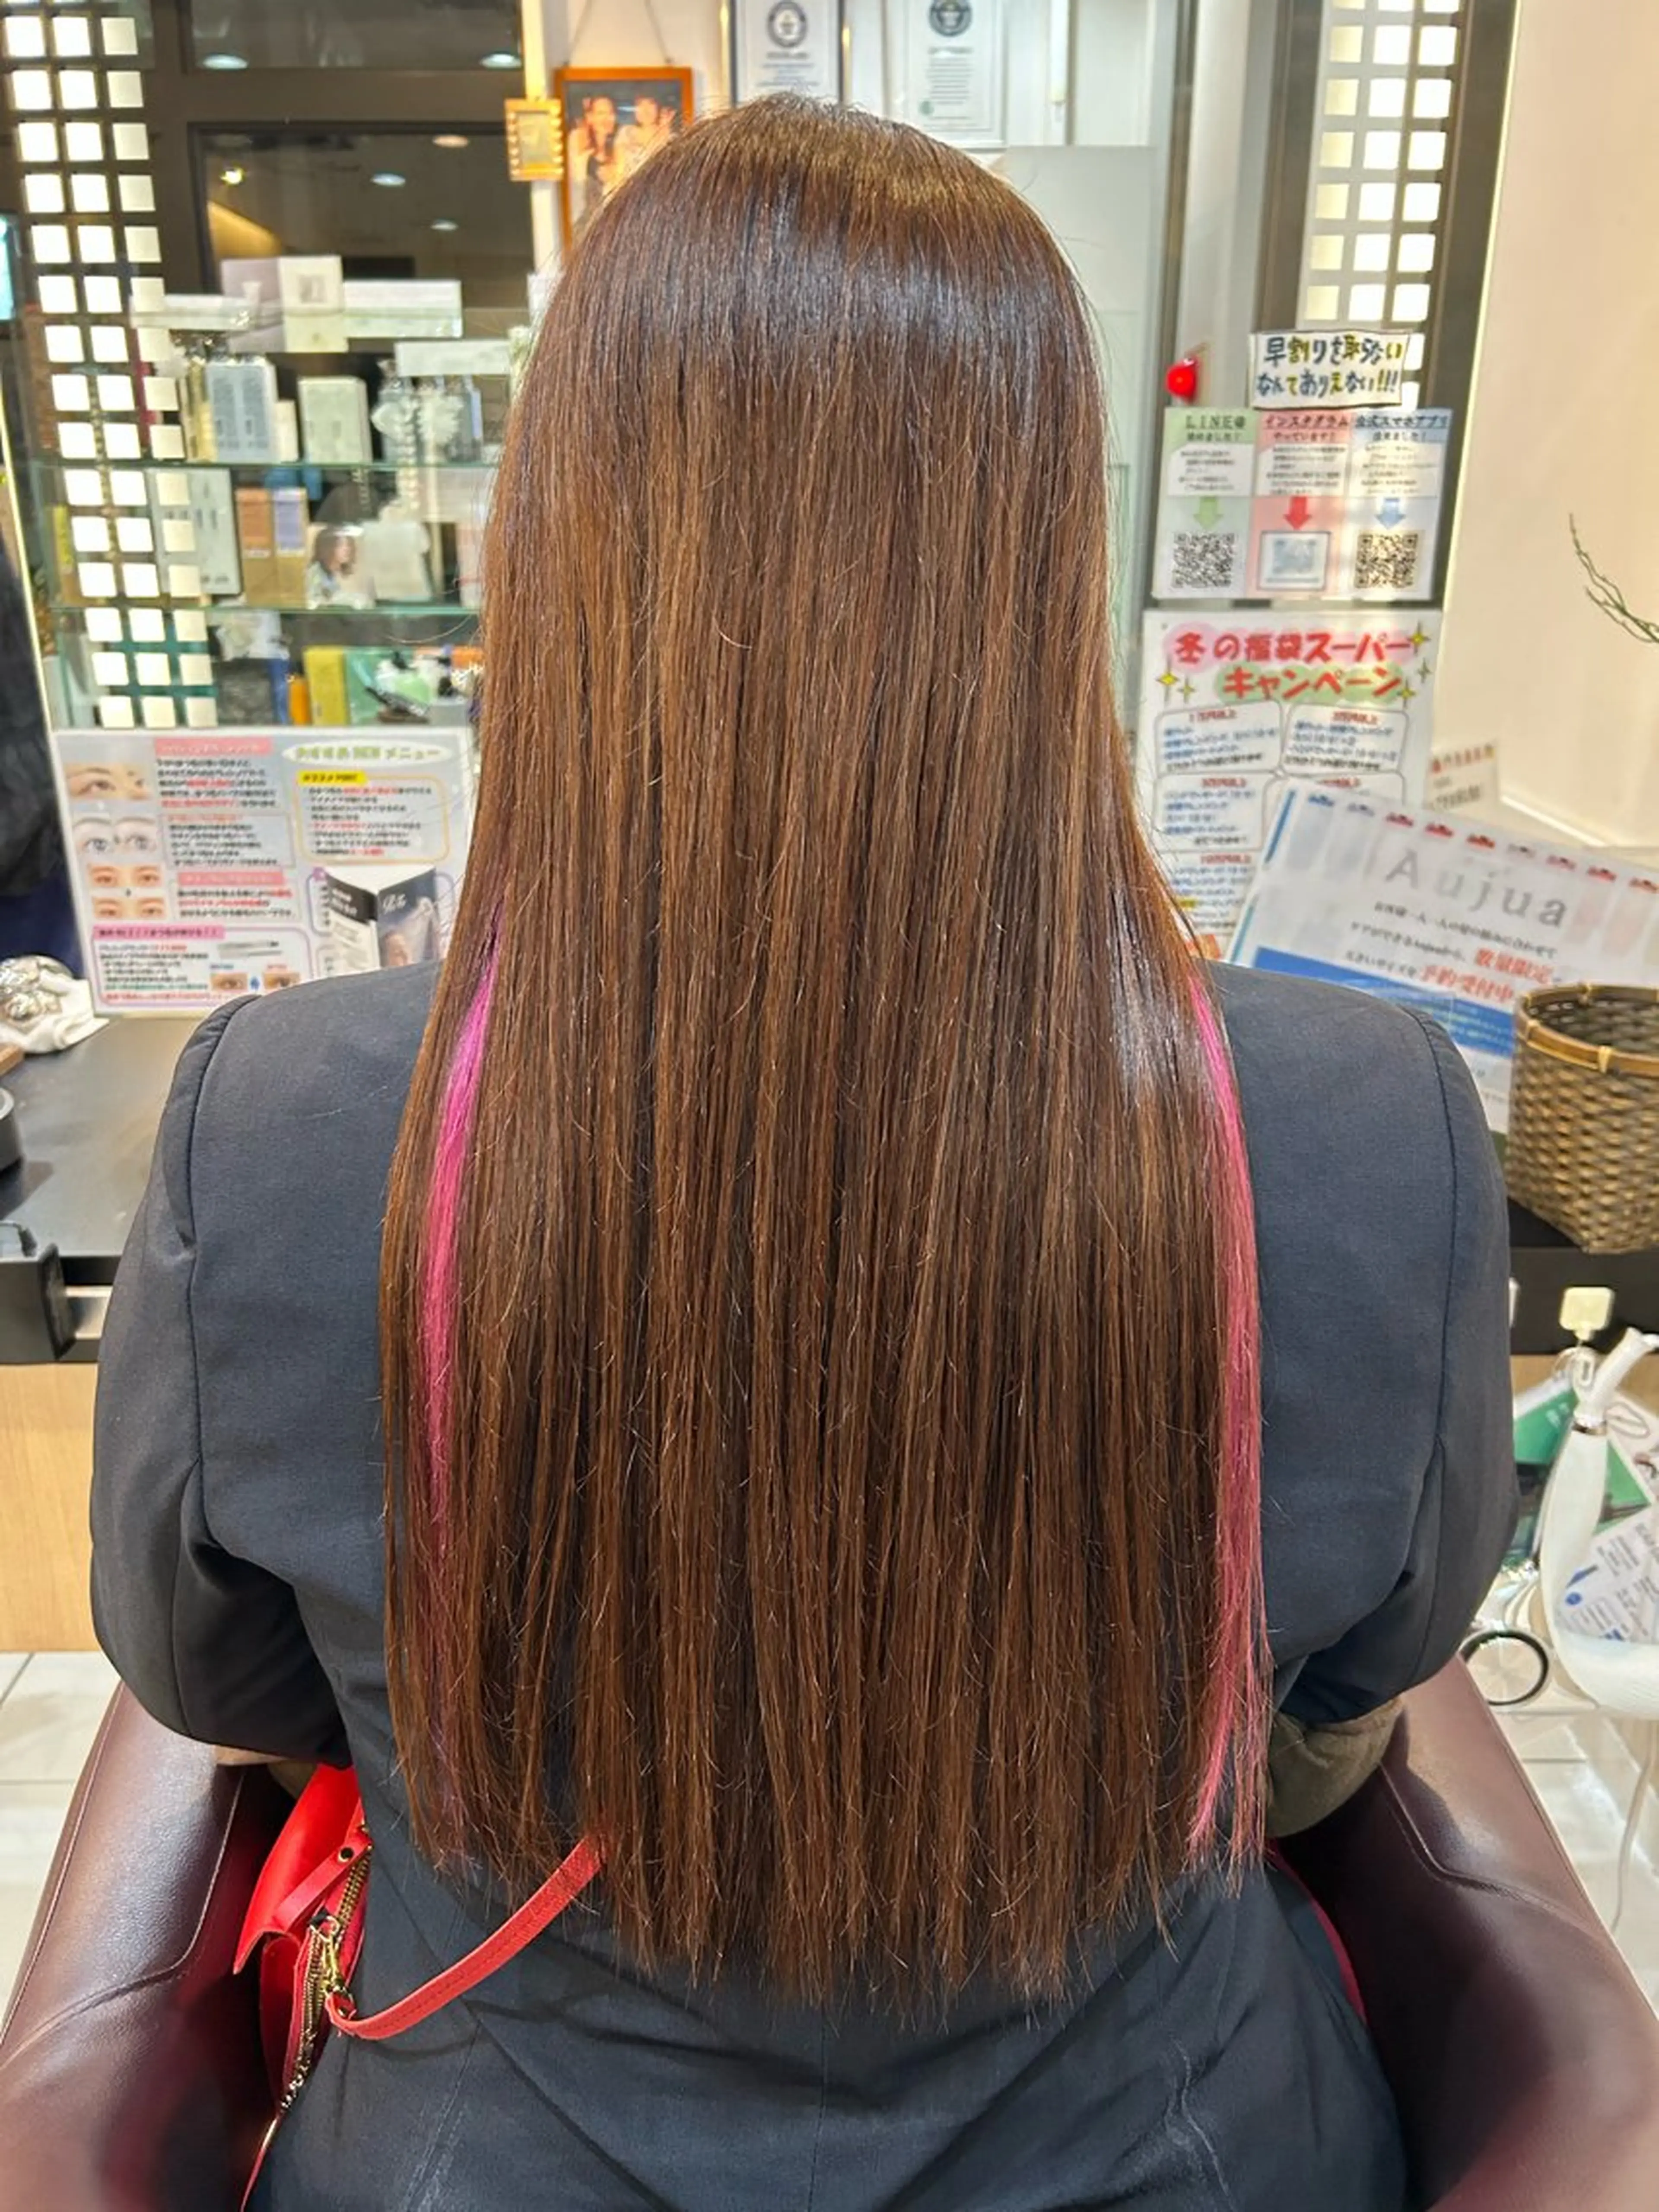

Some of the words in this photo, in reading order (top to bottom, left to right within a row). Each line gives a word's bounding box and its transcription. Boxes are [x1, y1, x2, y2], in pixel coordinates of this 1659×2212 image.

[1176, 632, 1411, 663] 冬の福袋スーパー
[1223, 666, 1402, 700] キャンペーン
[1385, 849, 1567, 928] Aujua
